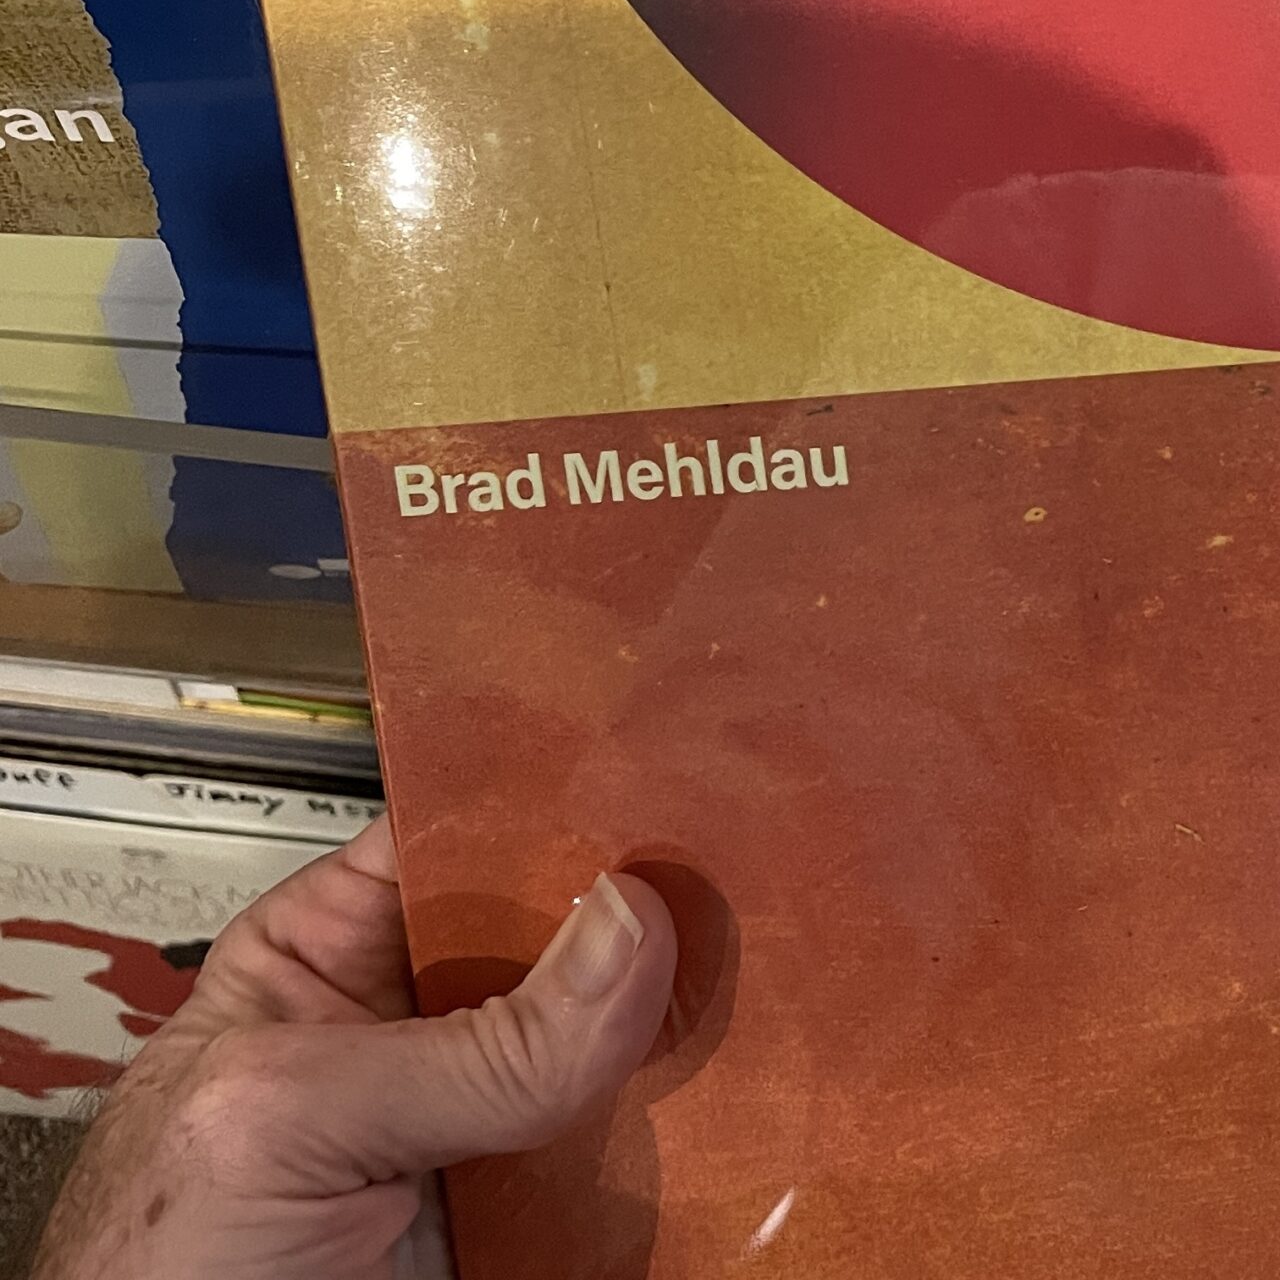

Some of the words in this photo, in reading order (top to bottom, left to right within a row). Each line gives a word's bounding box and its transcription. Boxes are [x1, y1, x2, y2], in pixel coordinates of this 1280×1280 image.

[0, 107, 116, 151] an
[393, 452, 547, 517] Brad
[562, 435, 850, 506] Mehldau
